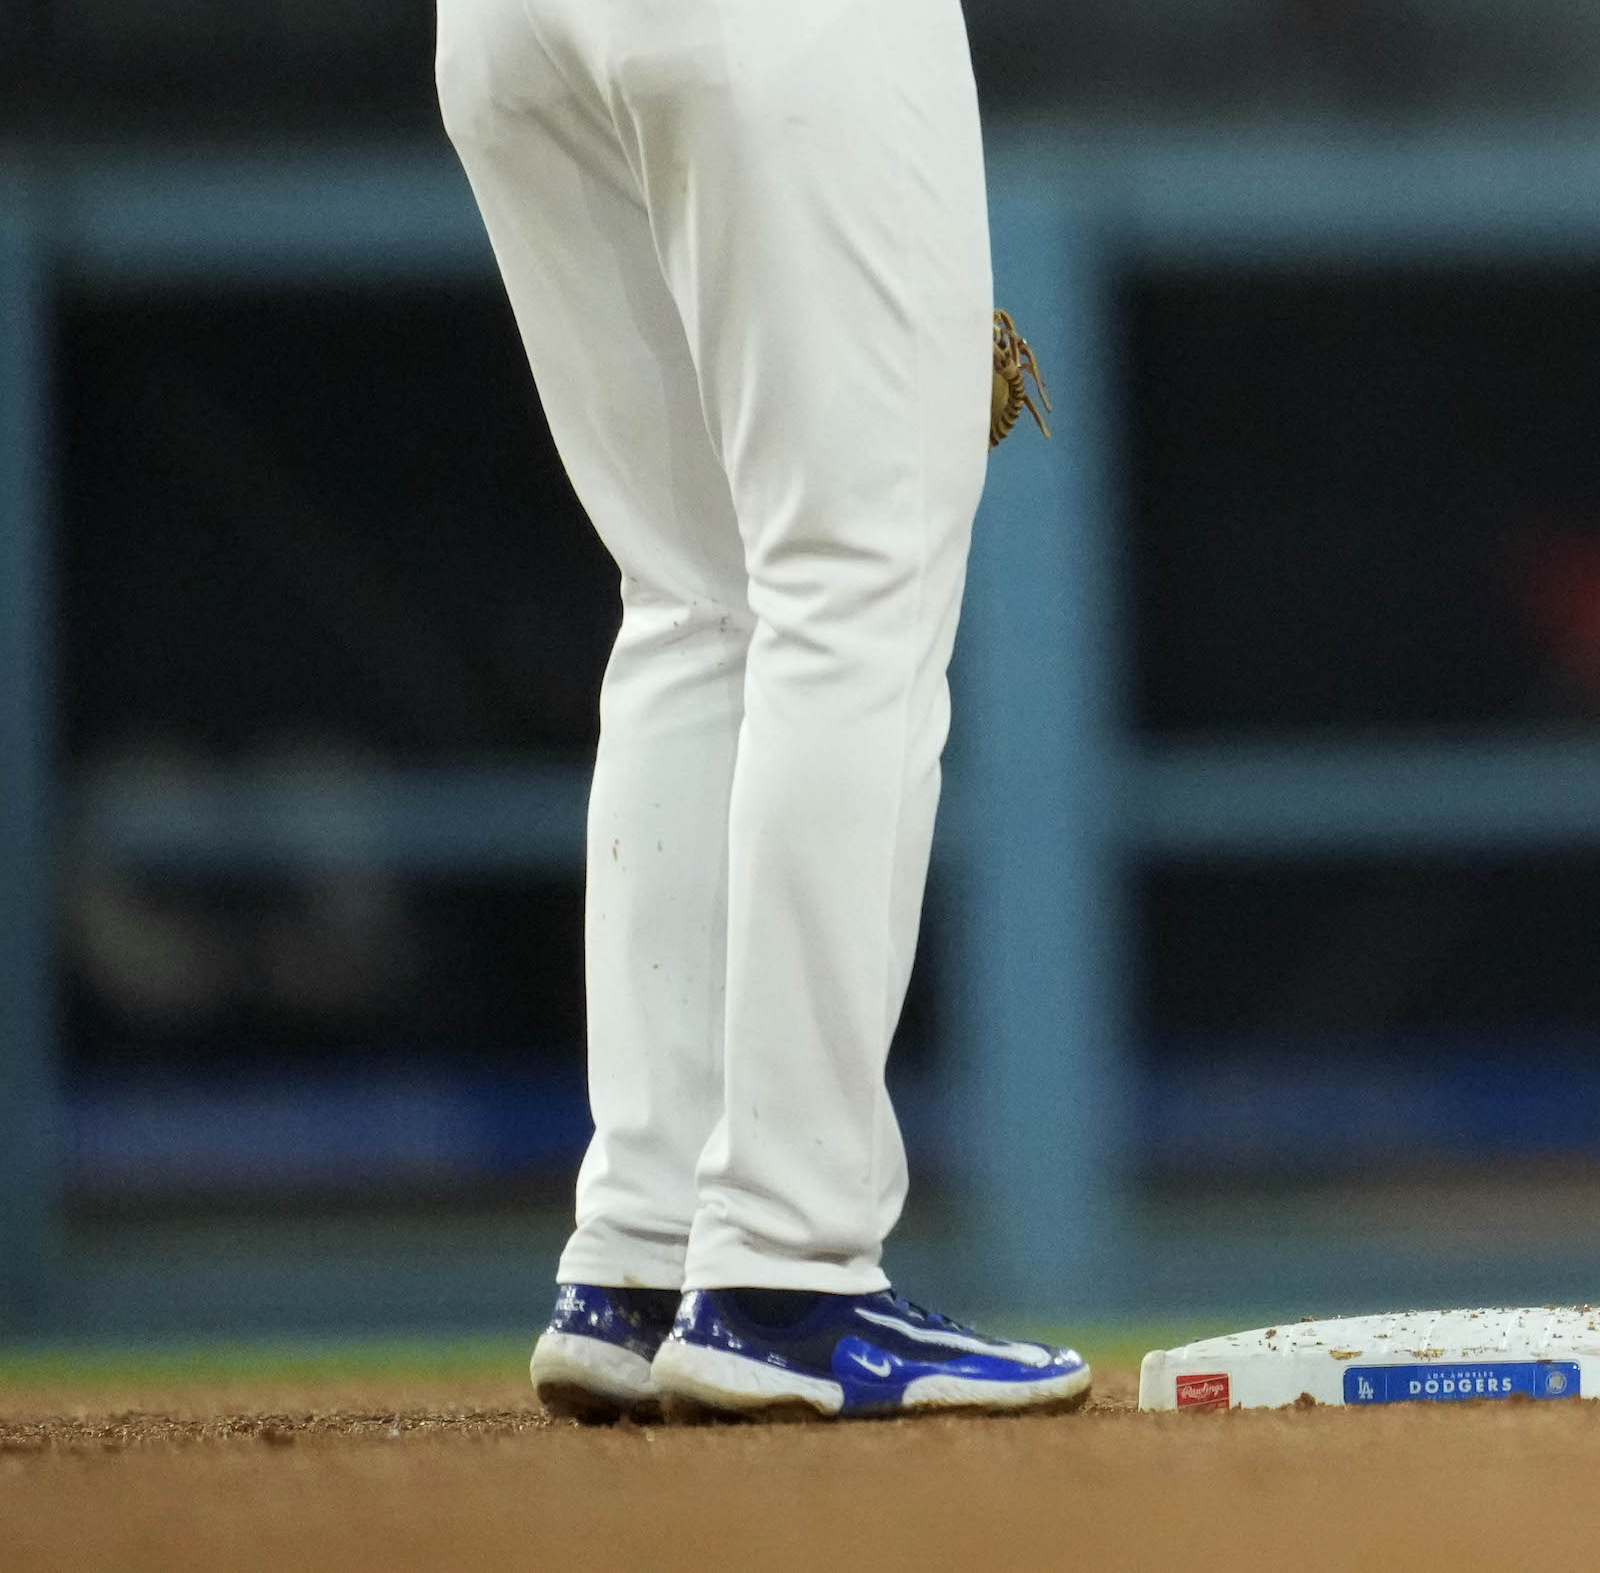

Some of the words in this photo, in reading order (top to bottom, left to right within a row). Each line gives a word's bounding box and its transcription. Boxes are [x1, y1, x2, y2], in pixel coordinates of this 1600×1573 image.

[1427, 1372, 1445, 1380] LOS
[1450, 1370, 1494, 1379] ANGELES
[1181, 1382, 1225, 1401] Rawlings
[1357, 1376, 1375, 1400] LA
[1409, 1377, 1512, 1395] DODGERS
